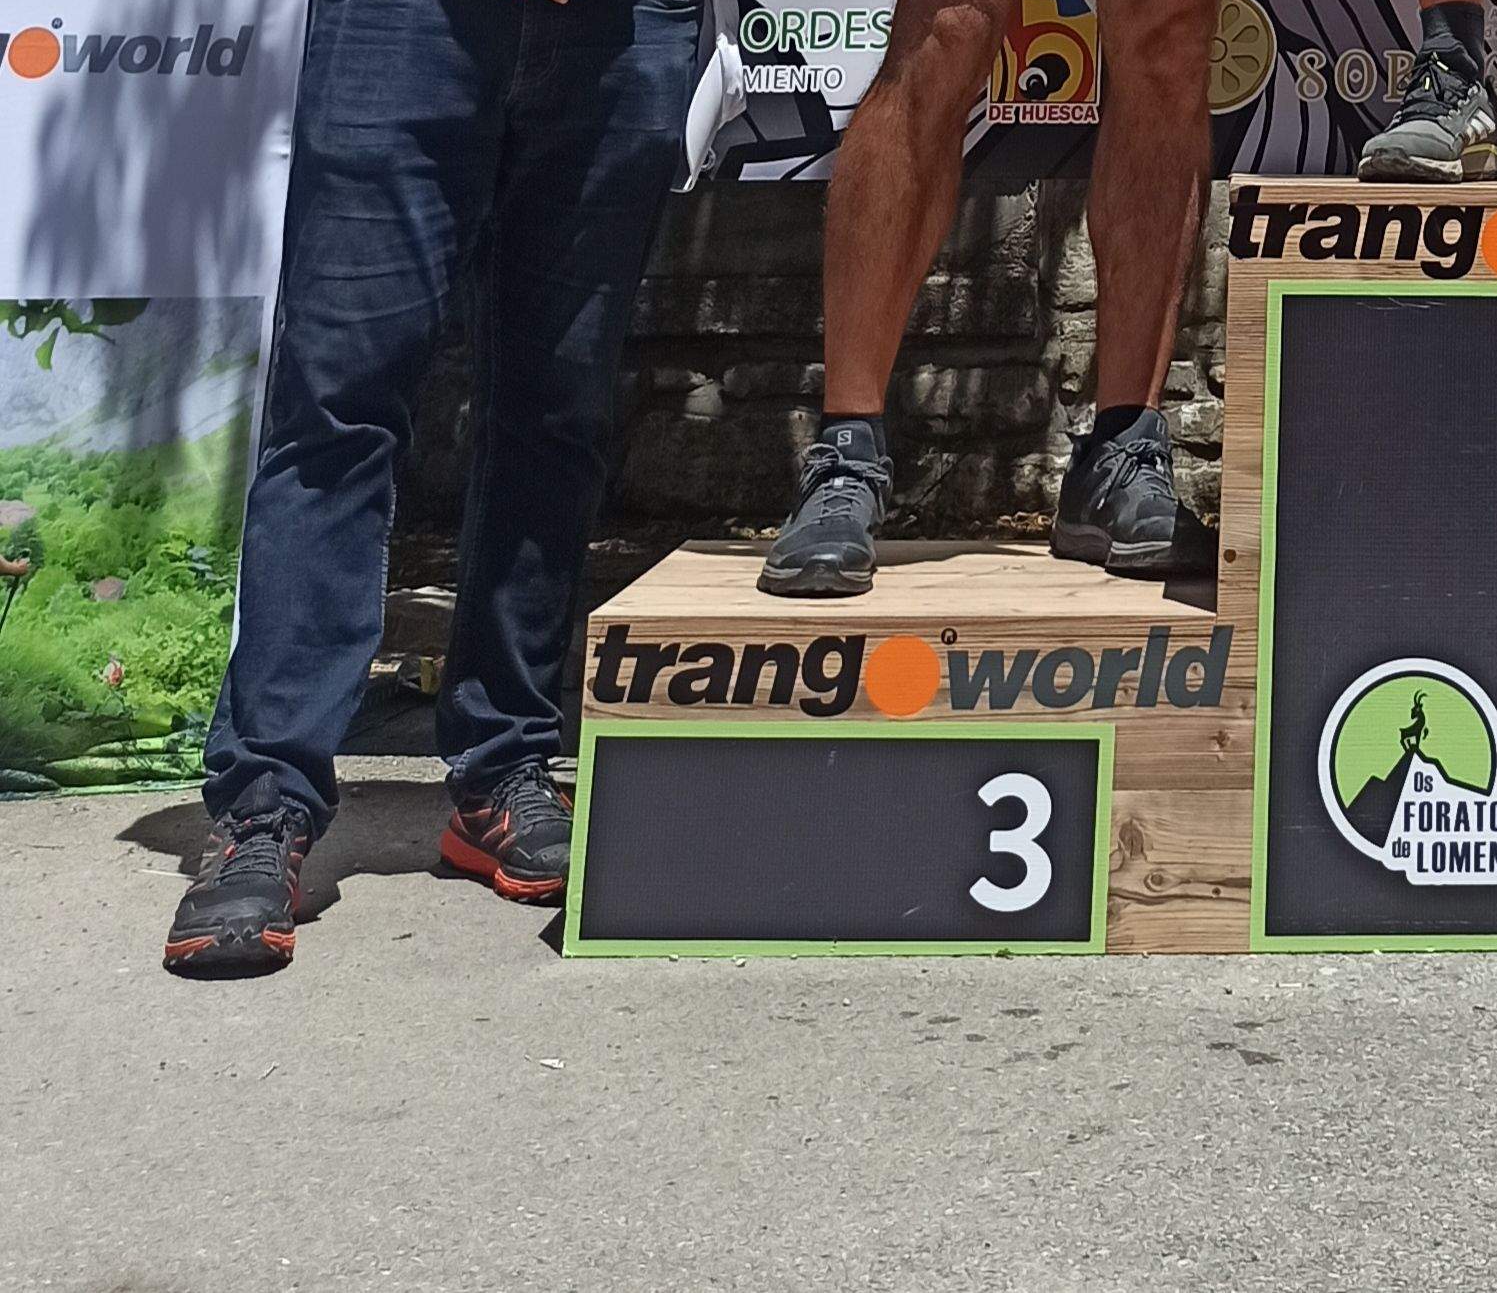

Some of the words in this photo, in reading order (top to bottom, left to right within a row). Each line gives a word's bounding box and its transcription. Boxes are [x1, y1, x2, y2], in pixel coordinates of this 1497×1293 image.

[989, 105, 1013, 121] DE
[1021, 105, 1097, 121] HUESCA
[591, 623, 1235, 718] trangoworld
[1414, 771, 1433, 792] Os
[969, 772, 1052, 912] 3
[1392, 837, 1410, 858] de
